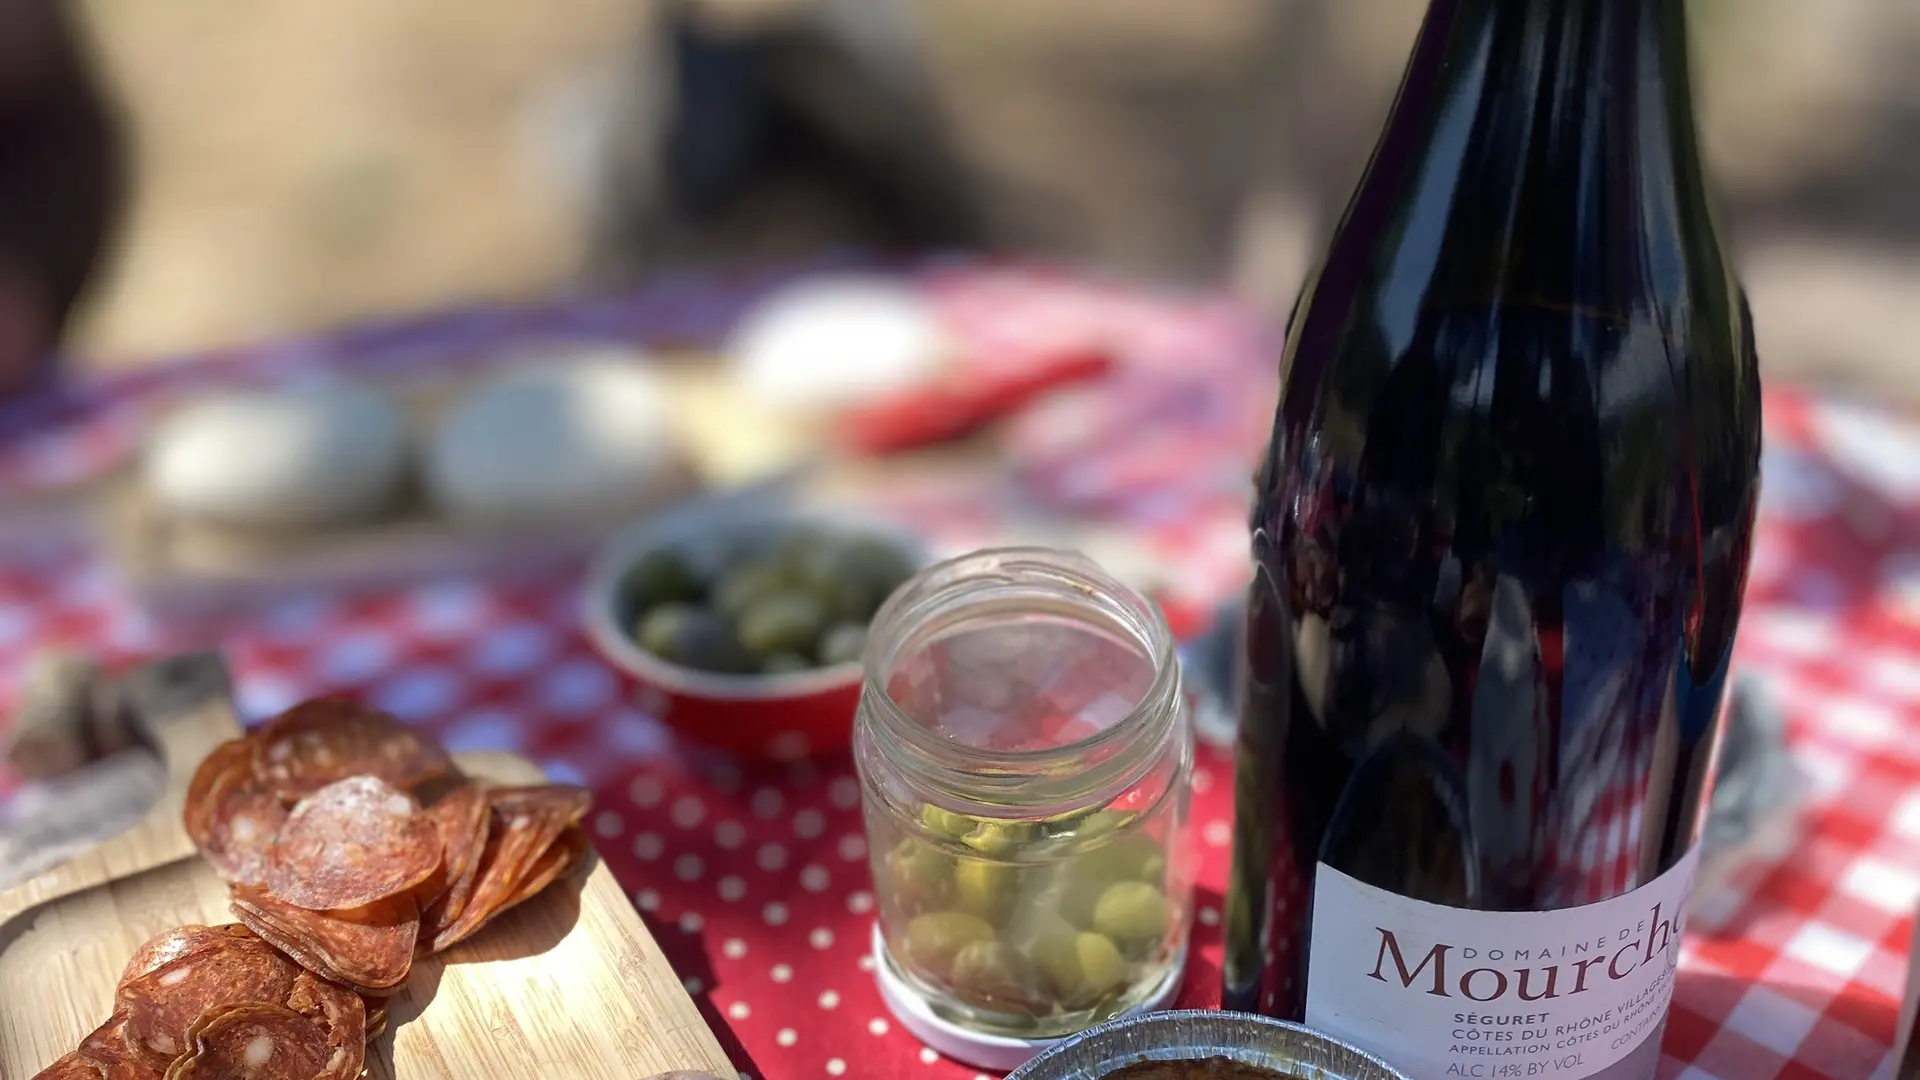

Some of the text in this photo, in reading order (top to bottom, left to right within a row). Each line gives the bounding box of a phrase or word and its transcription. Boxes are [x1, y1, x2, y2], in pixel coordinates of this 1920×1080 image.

[1462, 920, 1645, 961] DOMAINE DE
[1449, 1042, 1550, 1056] APPELLATION
[1556, 1030, 1599, 1049] CÔTES
[1603, 1020, 1620, 1035] DU
[1623, 993, 1656, 1023] RHÔNE
[1452, 1028, 1513, 1042] CÔTES
[1521, 1028, 1548, 1041] DU
[1555, 1009, 1612, 1036] RHÔNE
[1453, 1012, 1550, 1026] SÉGURET
[1446, 1052, 1585, 1078] ALC 14% BY VOL
